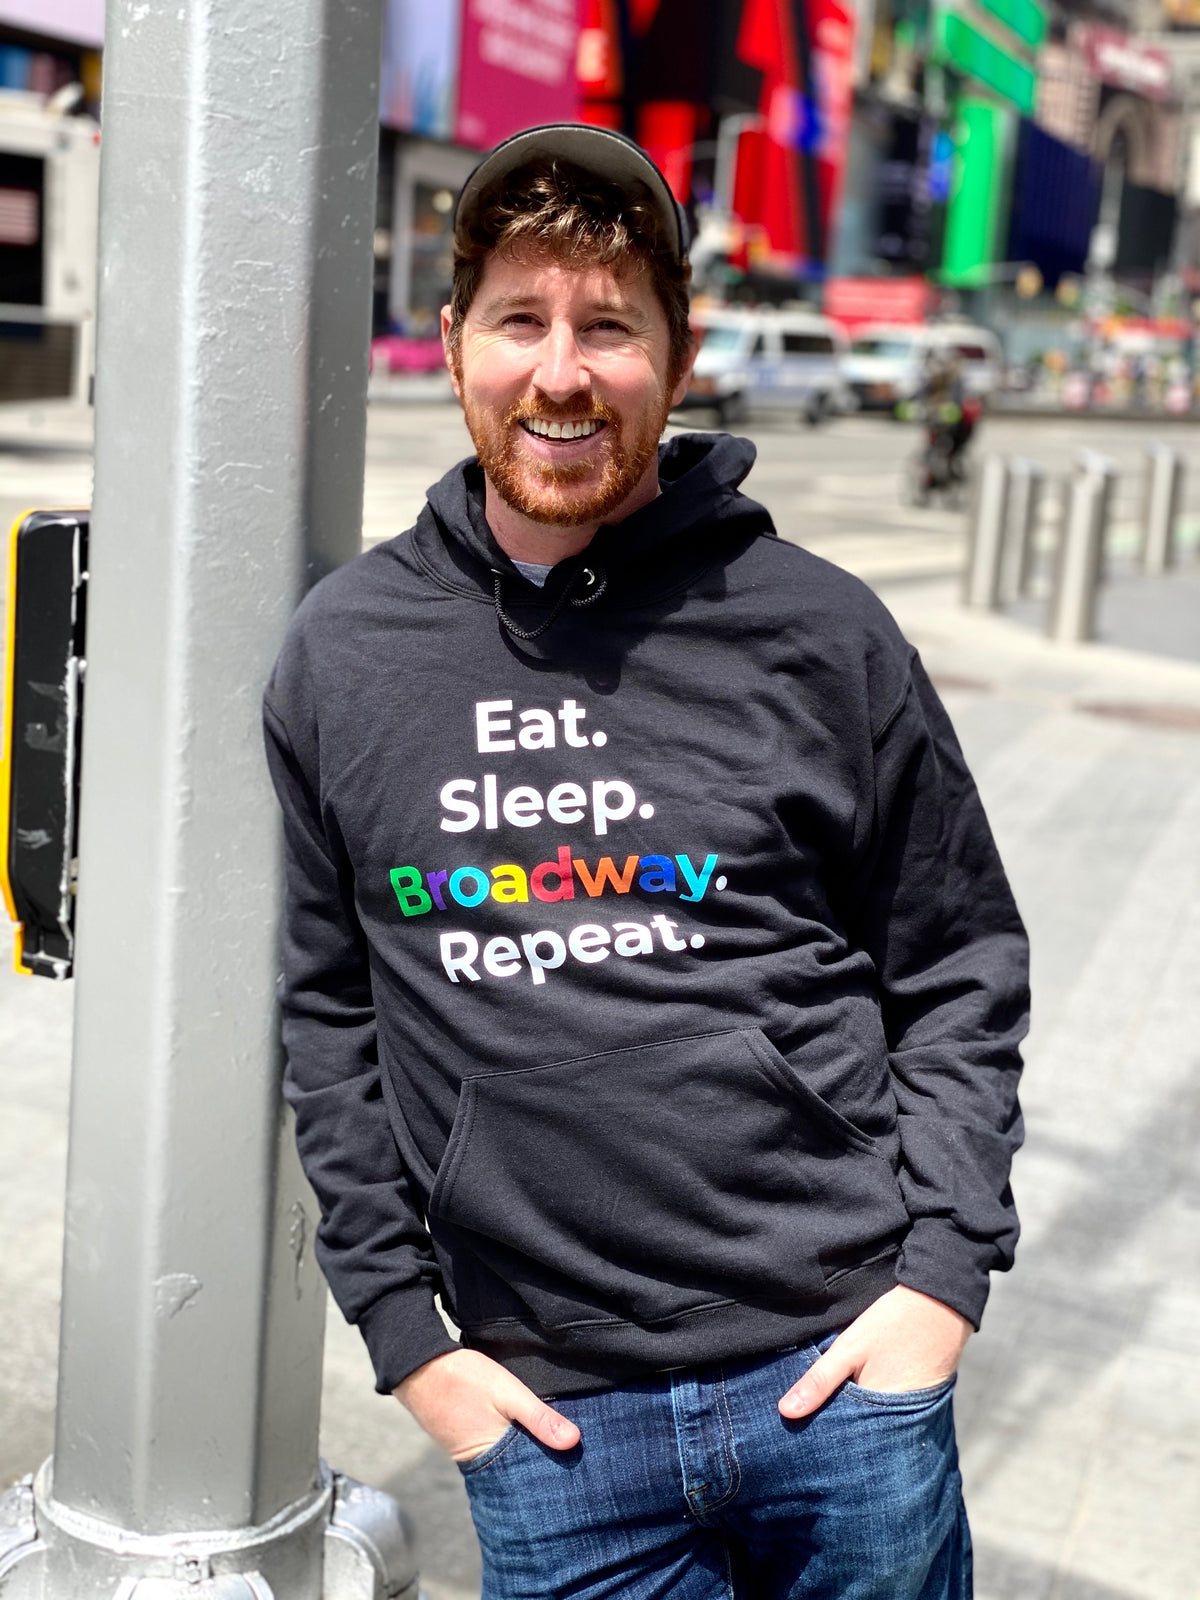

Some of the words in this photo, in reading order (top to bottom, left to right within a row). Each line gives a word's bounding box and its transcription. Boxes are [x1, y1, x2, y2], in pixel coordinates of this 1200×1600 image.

[475, 699, 608, 753] Eat.
[439, 774, 655, 835] Sleep.
[390, 846, 728, 917] Broadway.
[439, 914, 706, 985] Repeat.
